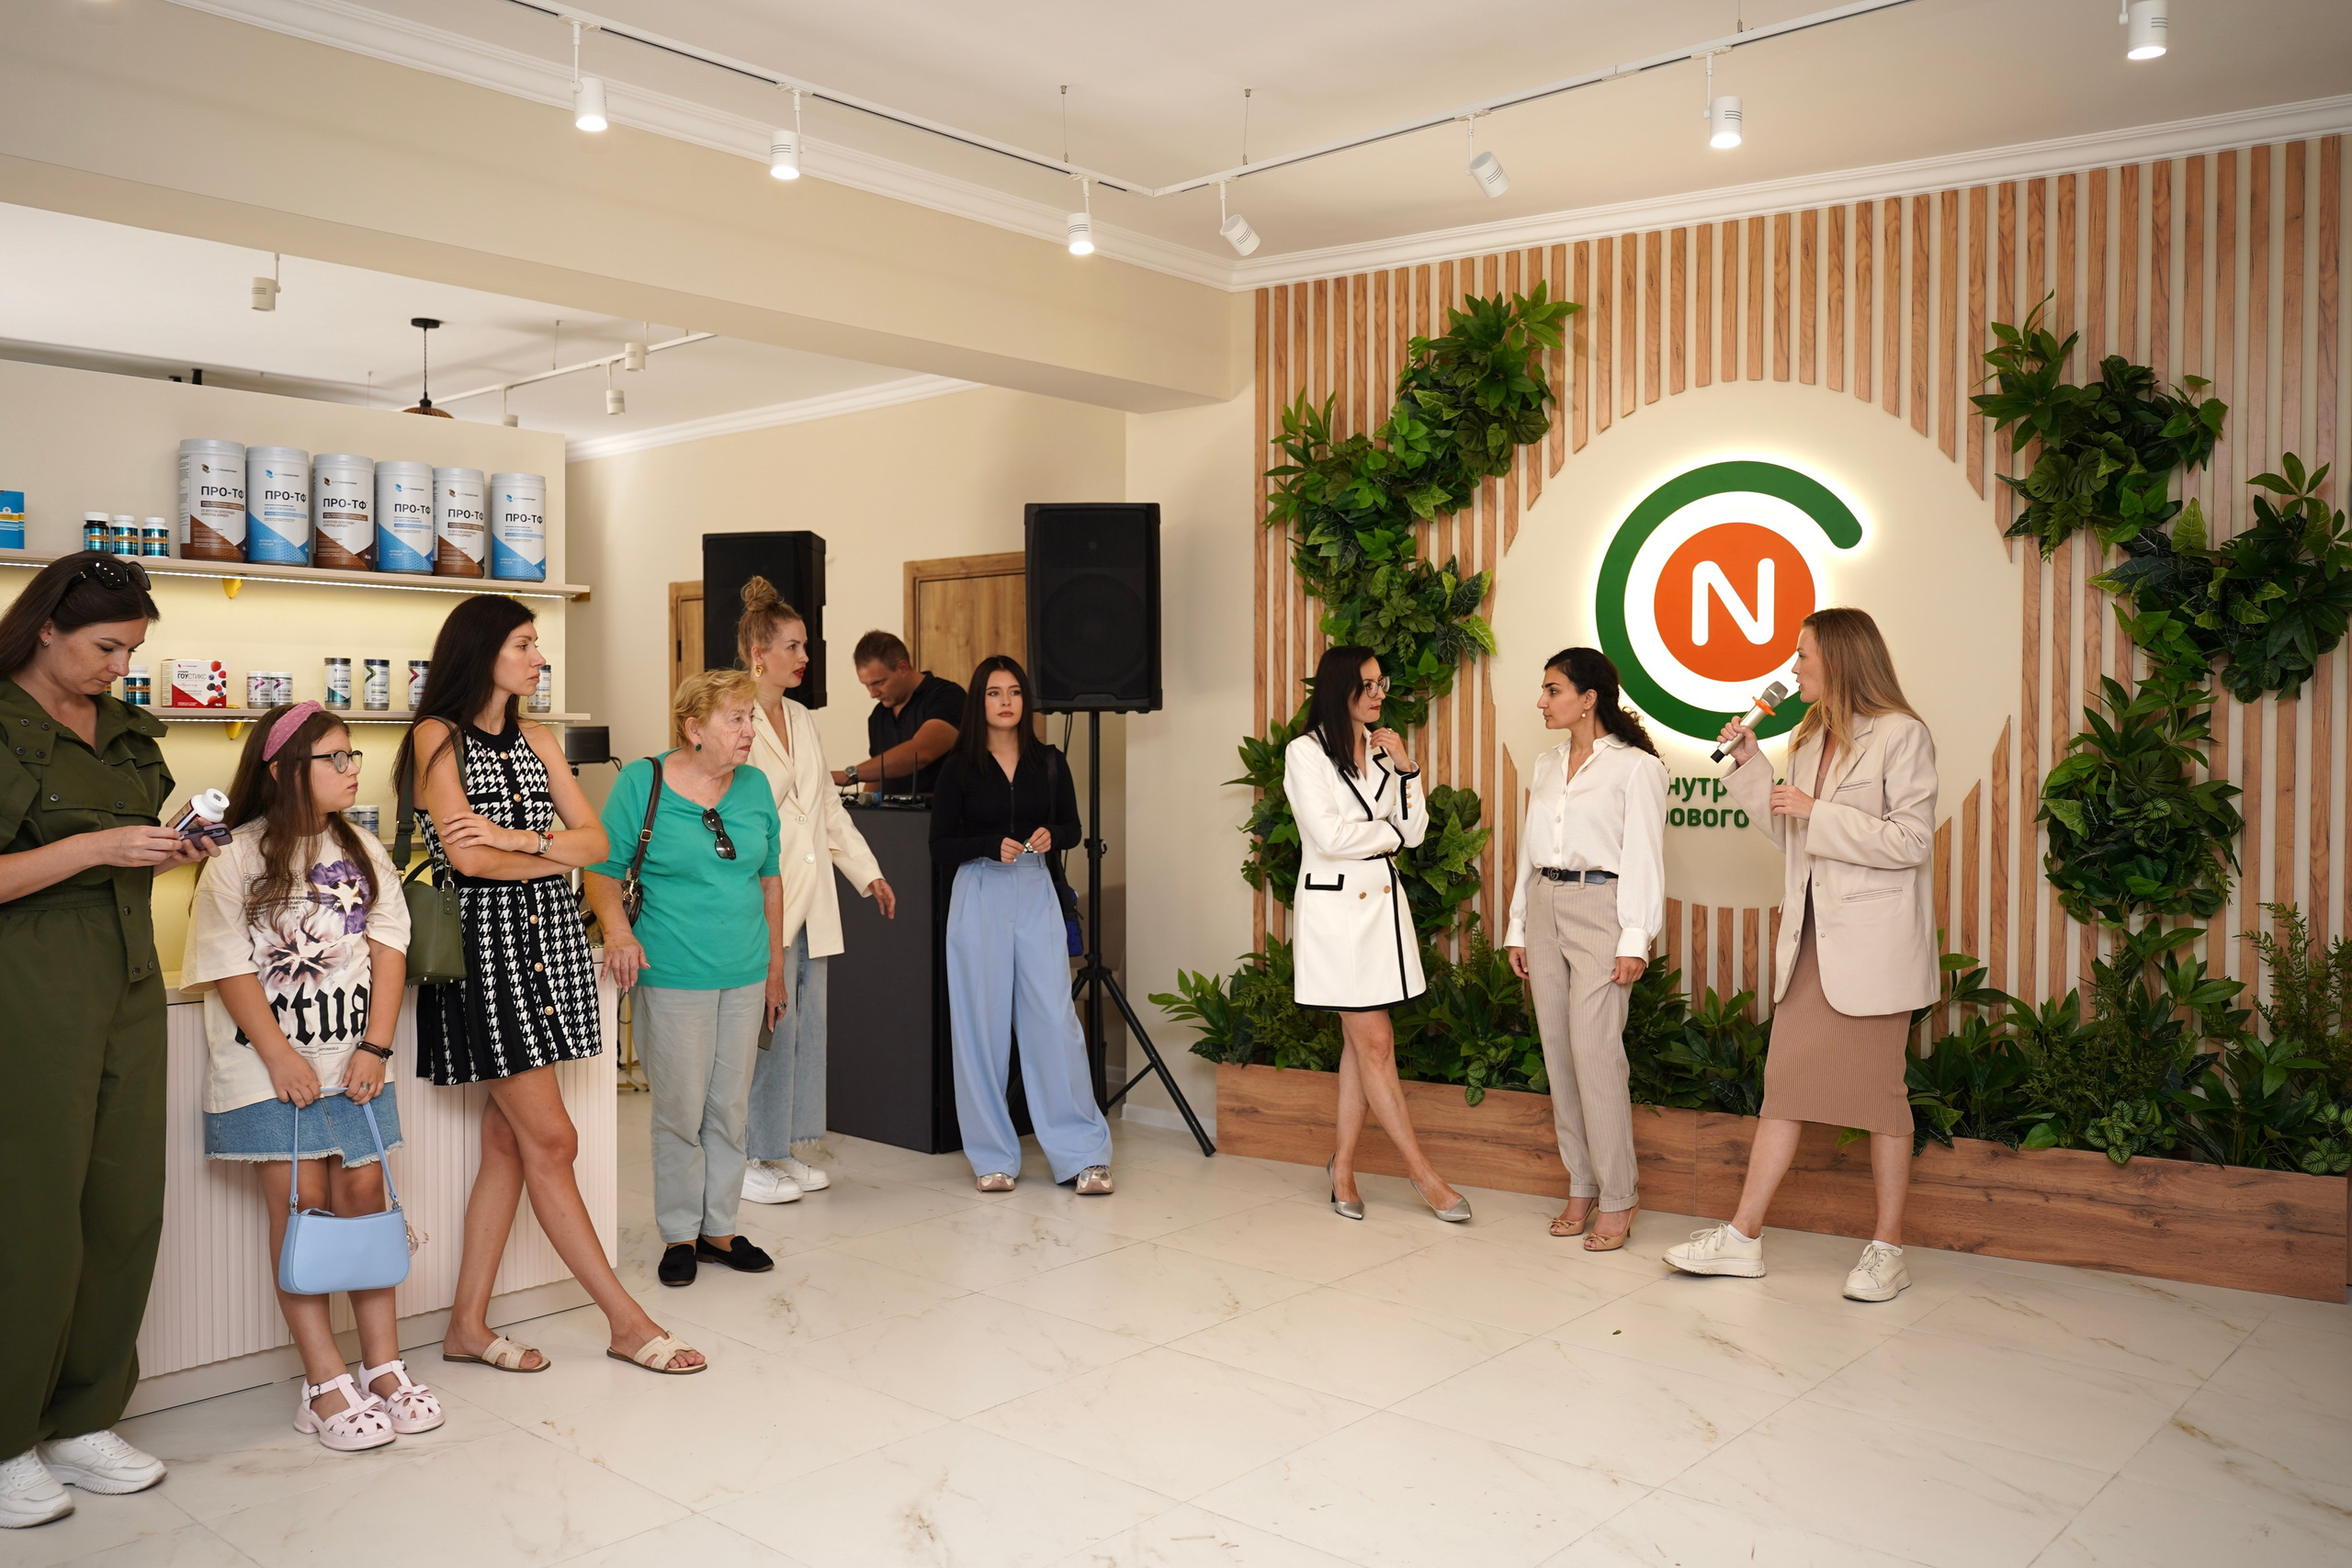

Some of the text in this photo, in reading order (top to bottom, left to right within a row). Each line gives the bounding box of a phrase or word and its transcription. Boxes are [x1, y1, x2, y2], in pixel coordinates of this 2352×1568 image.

[201, 486, 244, 499] ПРО-ТФ
[266, 491, 307, 502] ПРО-ТФ
[323, 499, 367, 510] ПРО-ТФ
[395, 503, 431, 514] ПРО-ТФ
[448, 509, 484, 521] ПРО-ТФ
[505, 513, 543, 524] ПРО-ТФ
[1691, 558, 1775, 646] N
[1666, 808, 1750, 828] ового
[235, 966, 371, 1046] ctua
